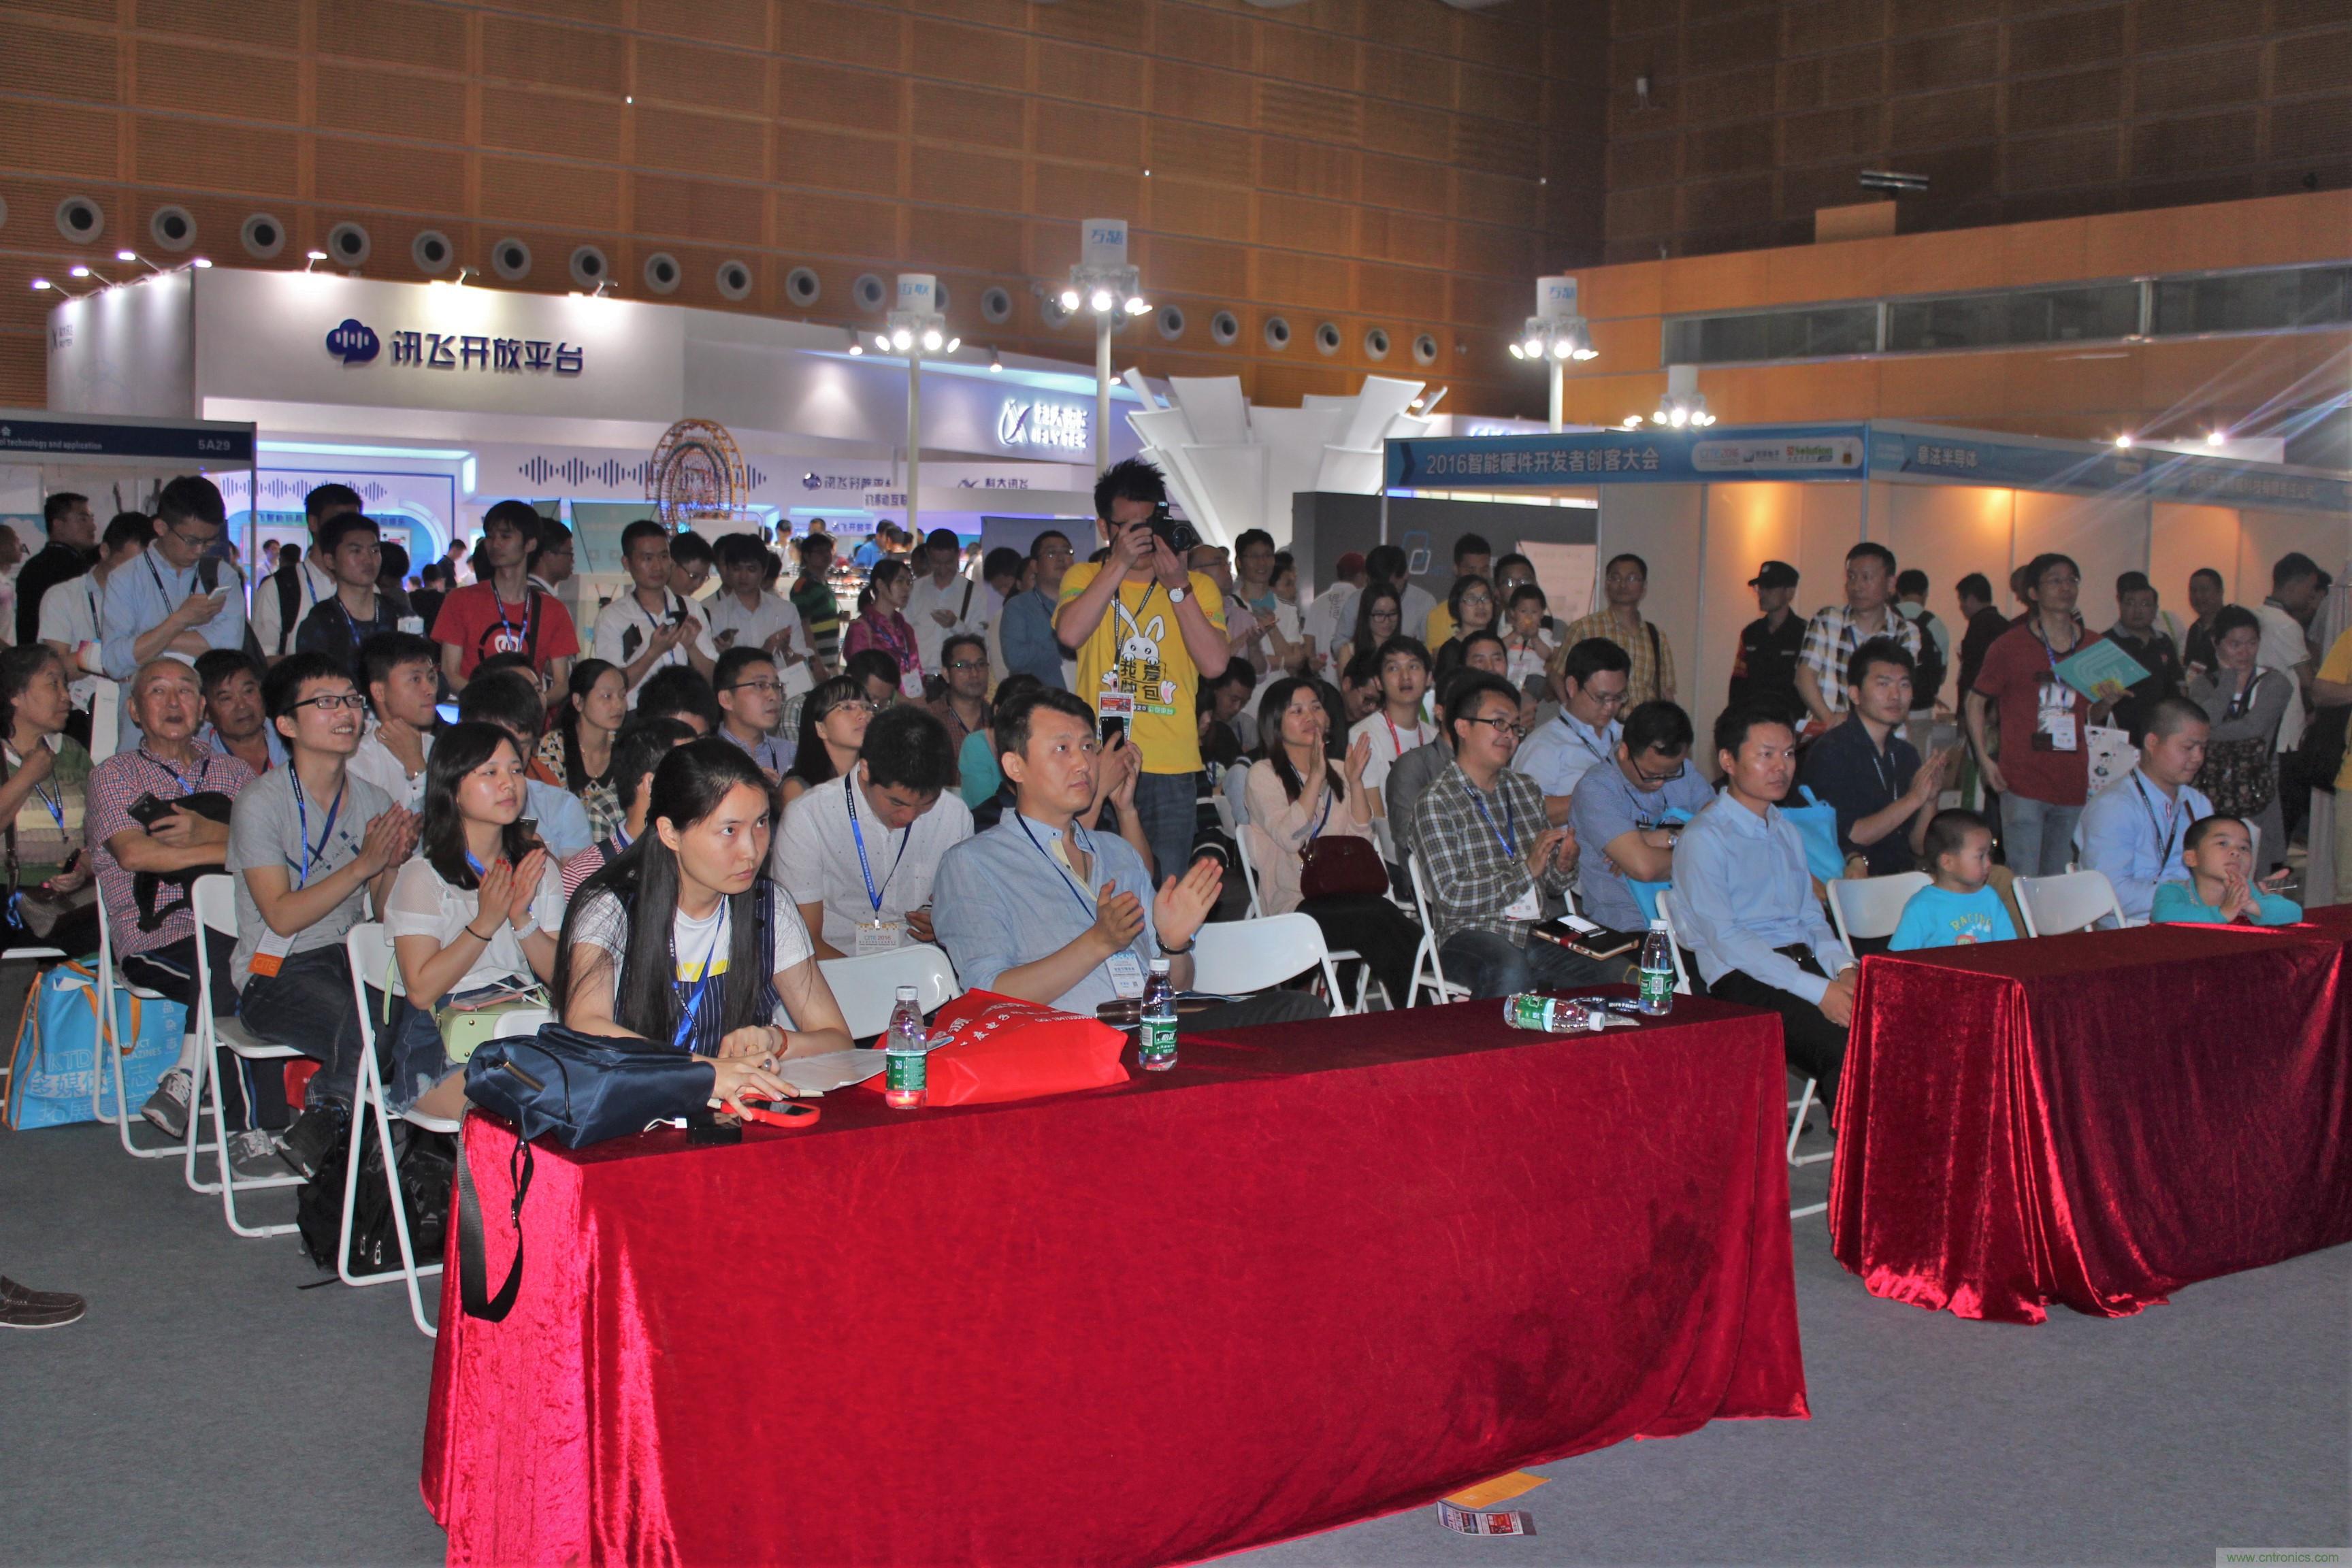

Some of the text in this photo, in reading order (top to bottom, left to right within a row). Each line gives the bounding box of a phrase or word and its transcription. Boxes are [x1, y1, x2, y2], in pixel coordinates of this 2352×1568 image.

[393, 330, 583, 373] 讯飞开放平台
[7, 438, 47, 449] technology
[48, 440, 62, 448] and
[63, 441, 102, 451] application
[198, 439, 230, 451] 5A29
[1426, 446, 1660, 474] 2016智能硬件开发者创客大会
[255, 958, 278, 972] CITE
